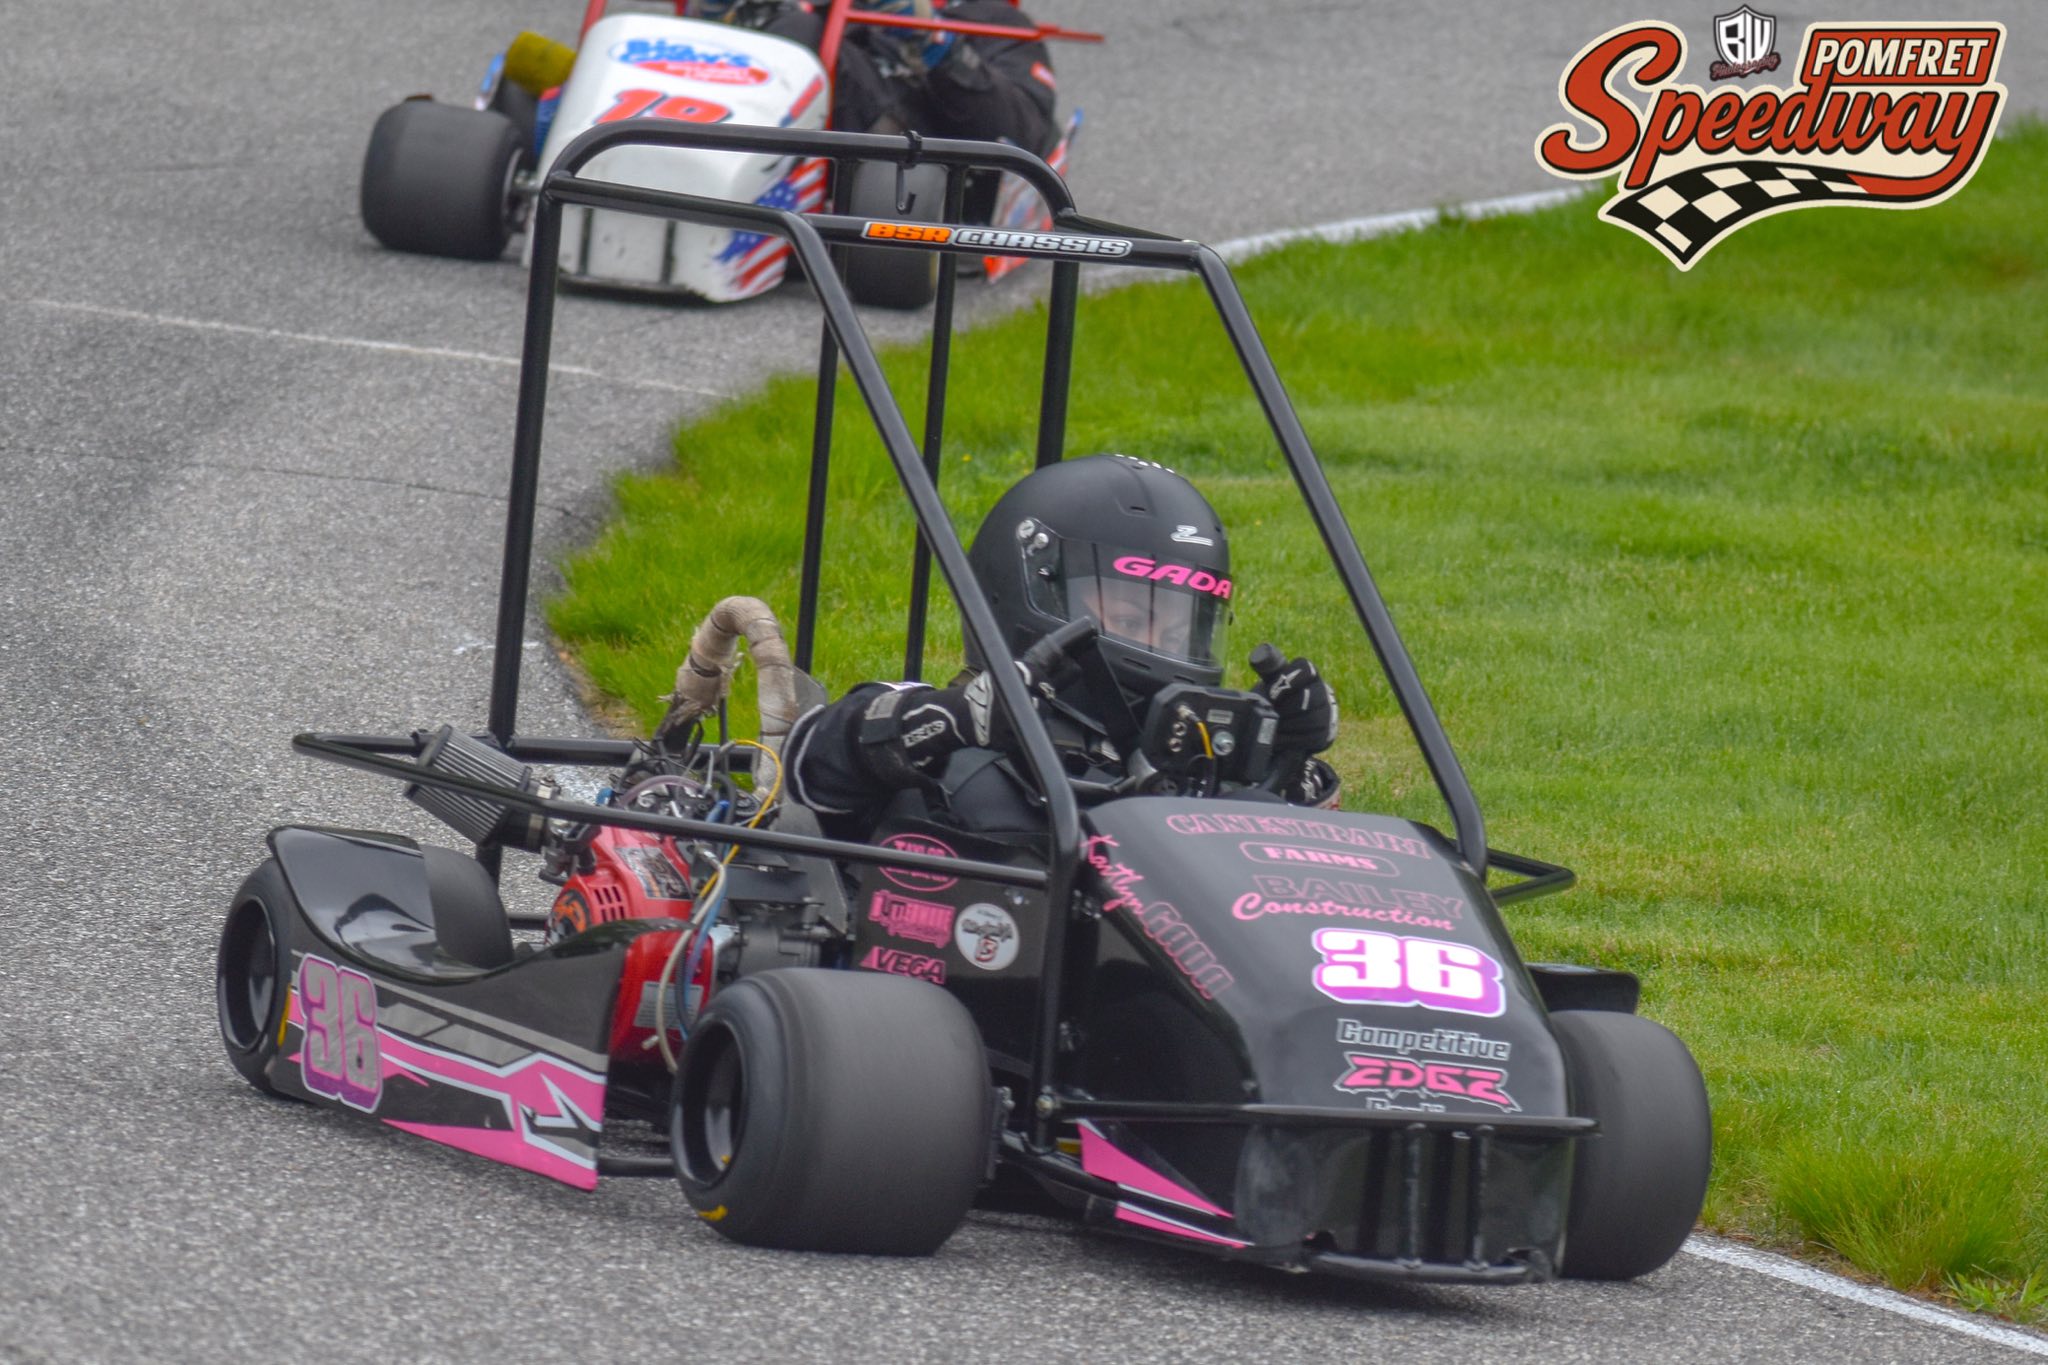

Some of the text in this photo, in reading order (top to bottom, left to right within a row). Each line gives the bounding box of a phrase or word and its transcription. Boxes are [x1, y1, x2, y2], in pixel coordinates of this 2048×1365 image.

[866, 222, 1128, 255] BSR CHASSIS
[1262, 846, 1379, 871] FARMS
[1231, 892, 1456, 931] Construction
[1252, 874, 1465, 919] BAILEY
[864, 946, 946, 985] VEGA
[1312, 927, 1506, 1018] 36
[299, 953, 383, 1114] 36
[1336, 1018, 1511, 1061] Competitive
[1339, 1054, 1513, 1106] EDGE
